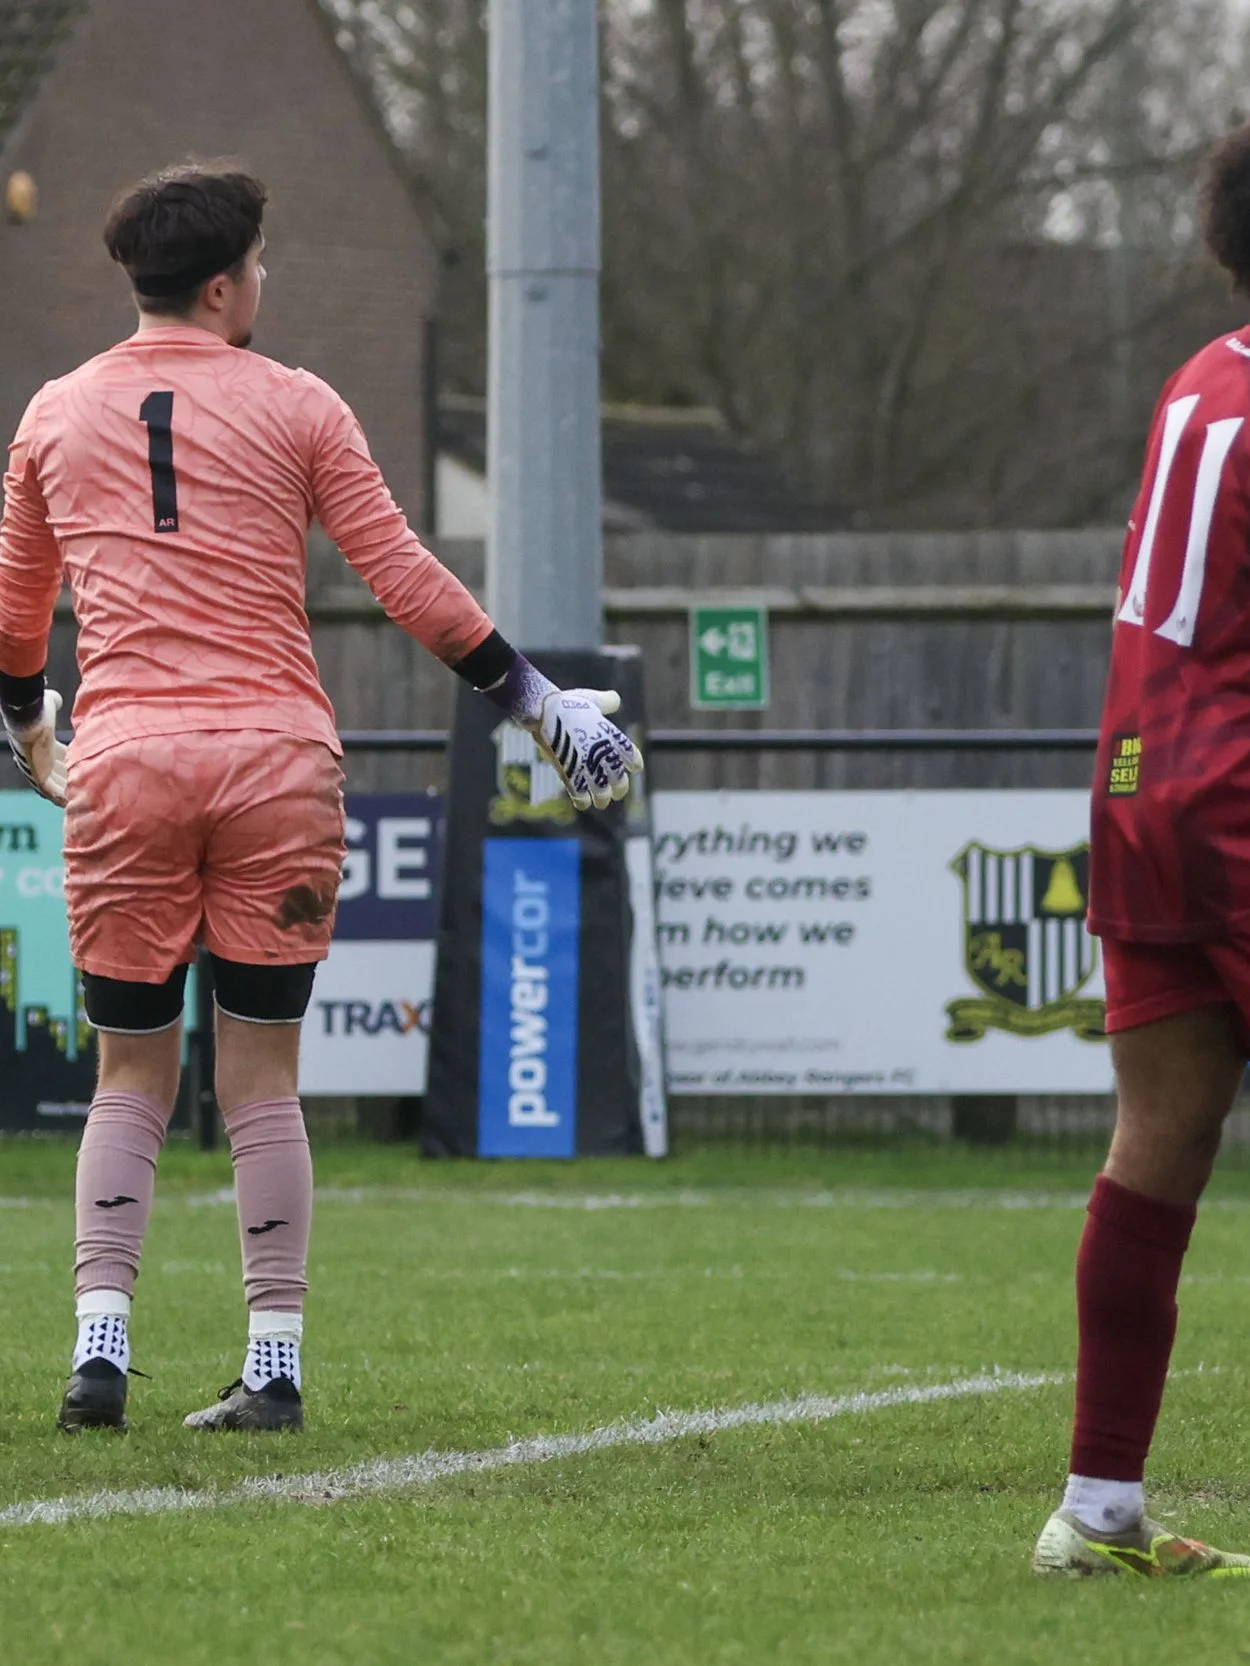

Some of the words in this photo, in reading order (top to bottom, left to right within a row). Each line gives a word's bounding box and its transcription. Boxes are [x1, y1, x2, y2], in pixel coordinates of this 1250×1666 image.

[139, 391, 178, 532] 1
[158, 517, 175, 527] AR
[1117, 393, 1245, 647] 11
[810, 830, 868, 853] we
[745, 876, 872, 899] comes
[703, 914, 786, 945] how
[800, 921, 855, 945] we
[508, 868, 561, 1128] powercor
